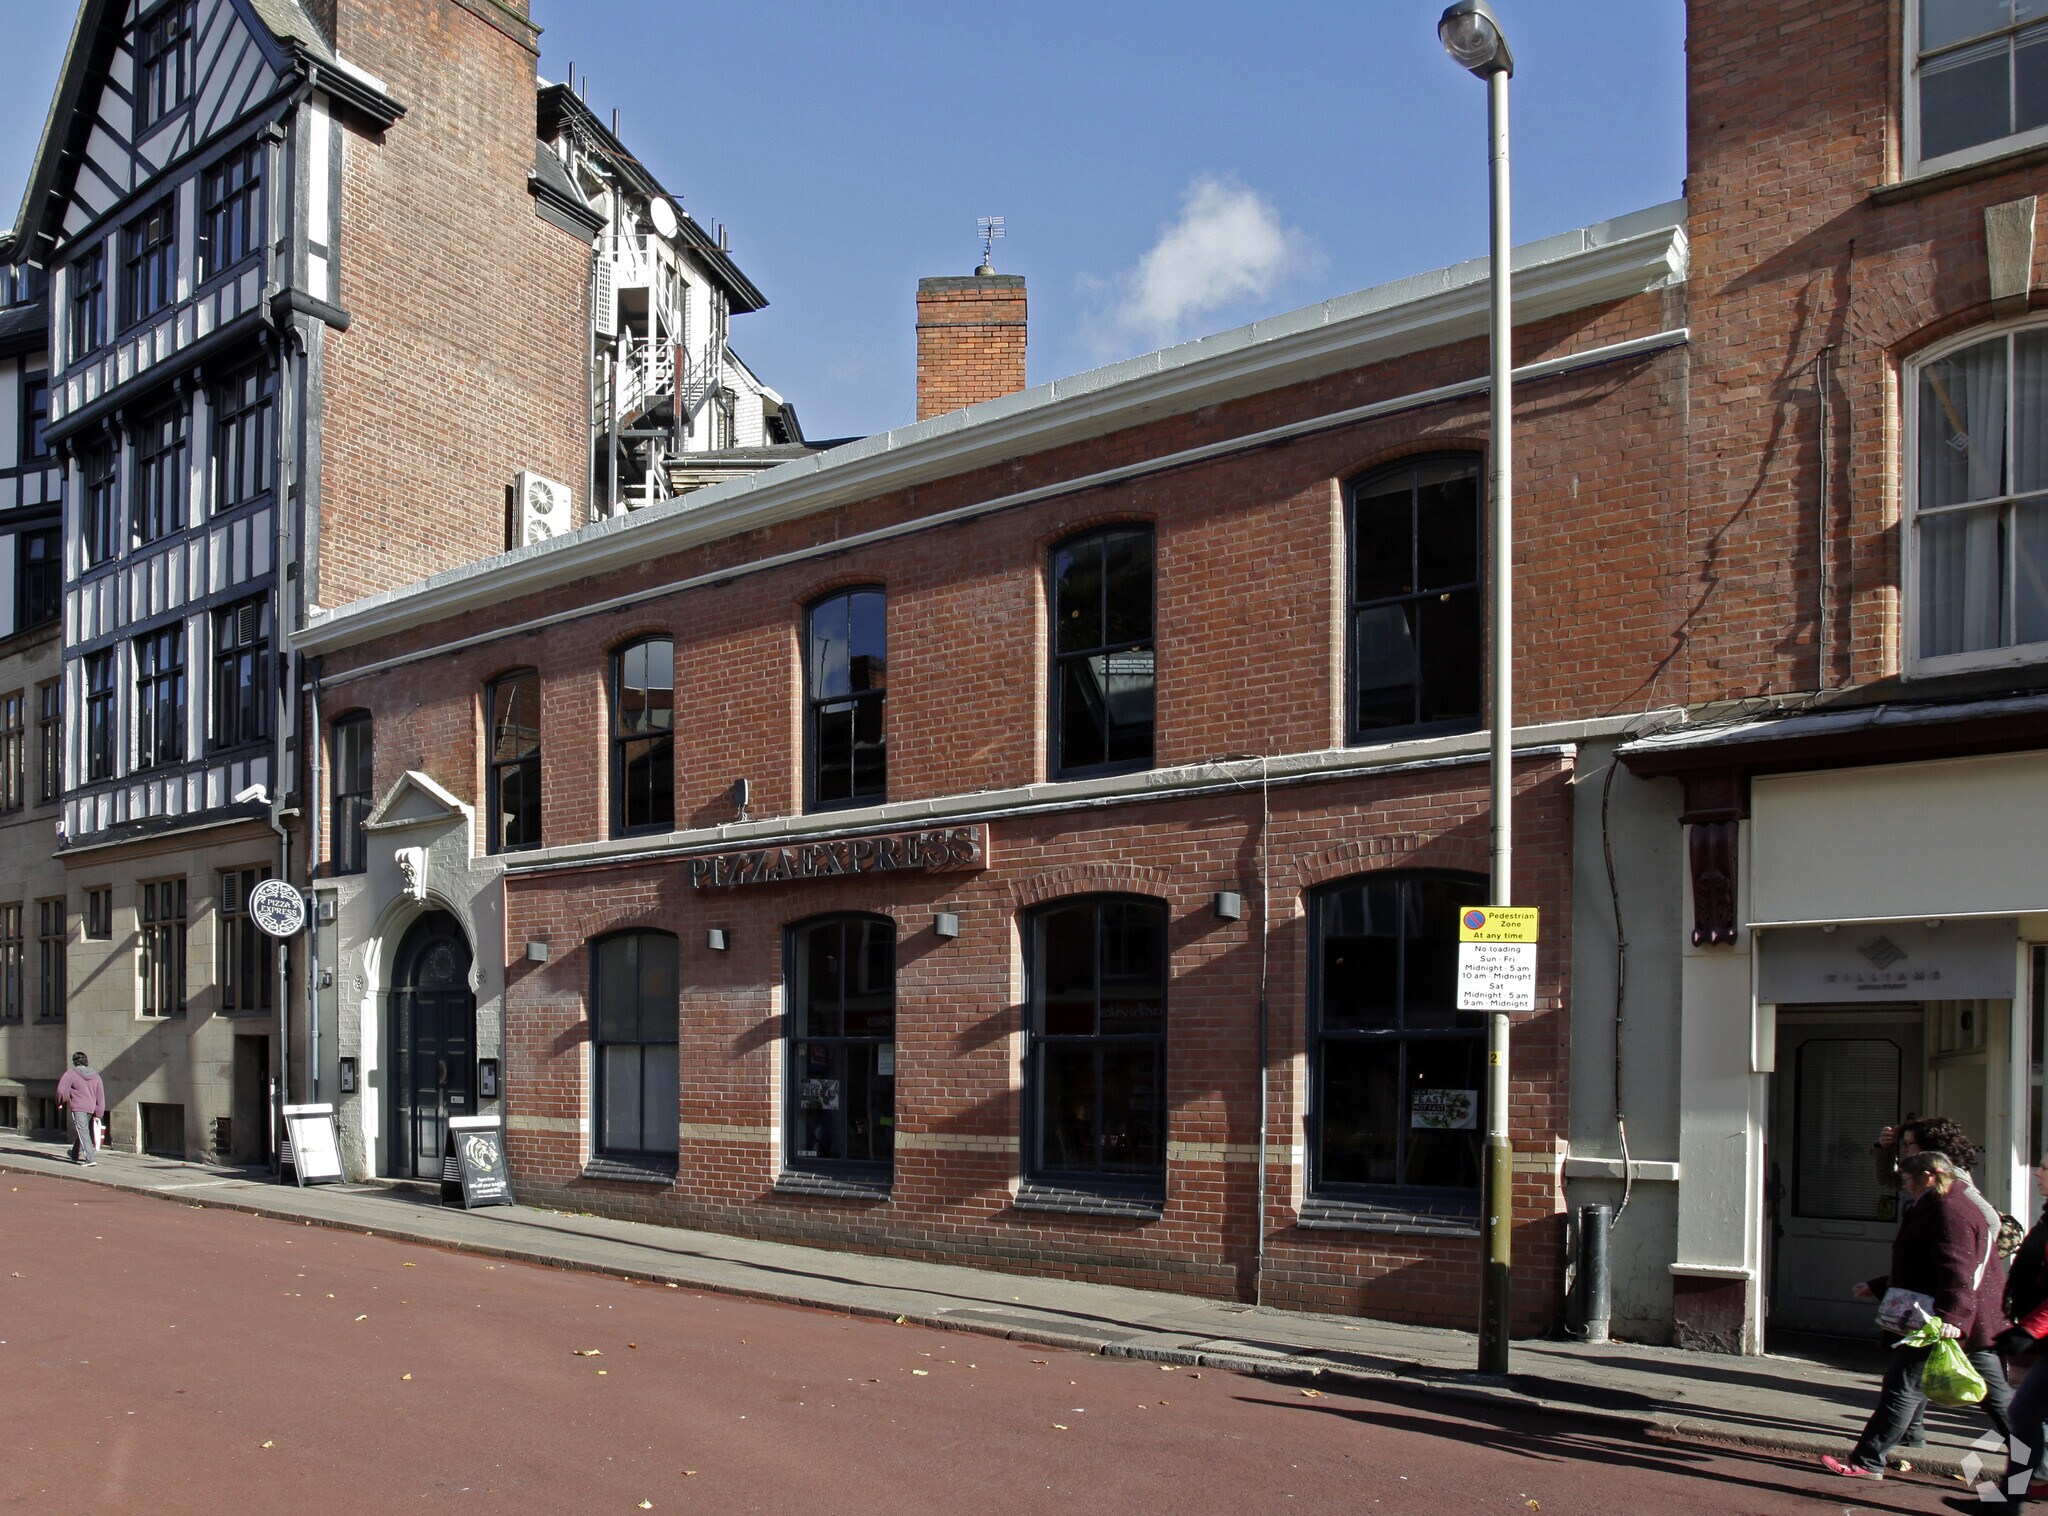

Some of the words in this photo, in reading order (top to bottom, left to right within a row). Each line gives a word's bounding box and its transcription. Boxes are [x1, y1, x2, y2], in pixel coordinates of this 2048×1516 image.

[267, 898, 291, 908] PIZZA
[261, 905, 297, 916] EXPRESS
[1490, 946, 1521, 954] loading
[1494, 973, 1532, 981] Midnight
[1490, 1054, 1498, 1064] 2
[1412, 1096, 1445, 1104] FEAST
